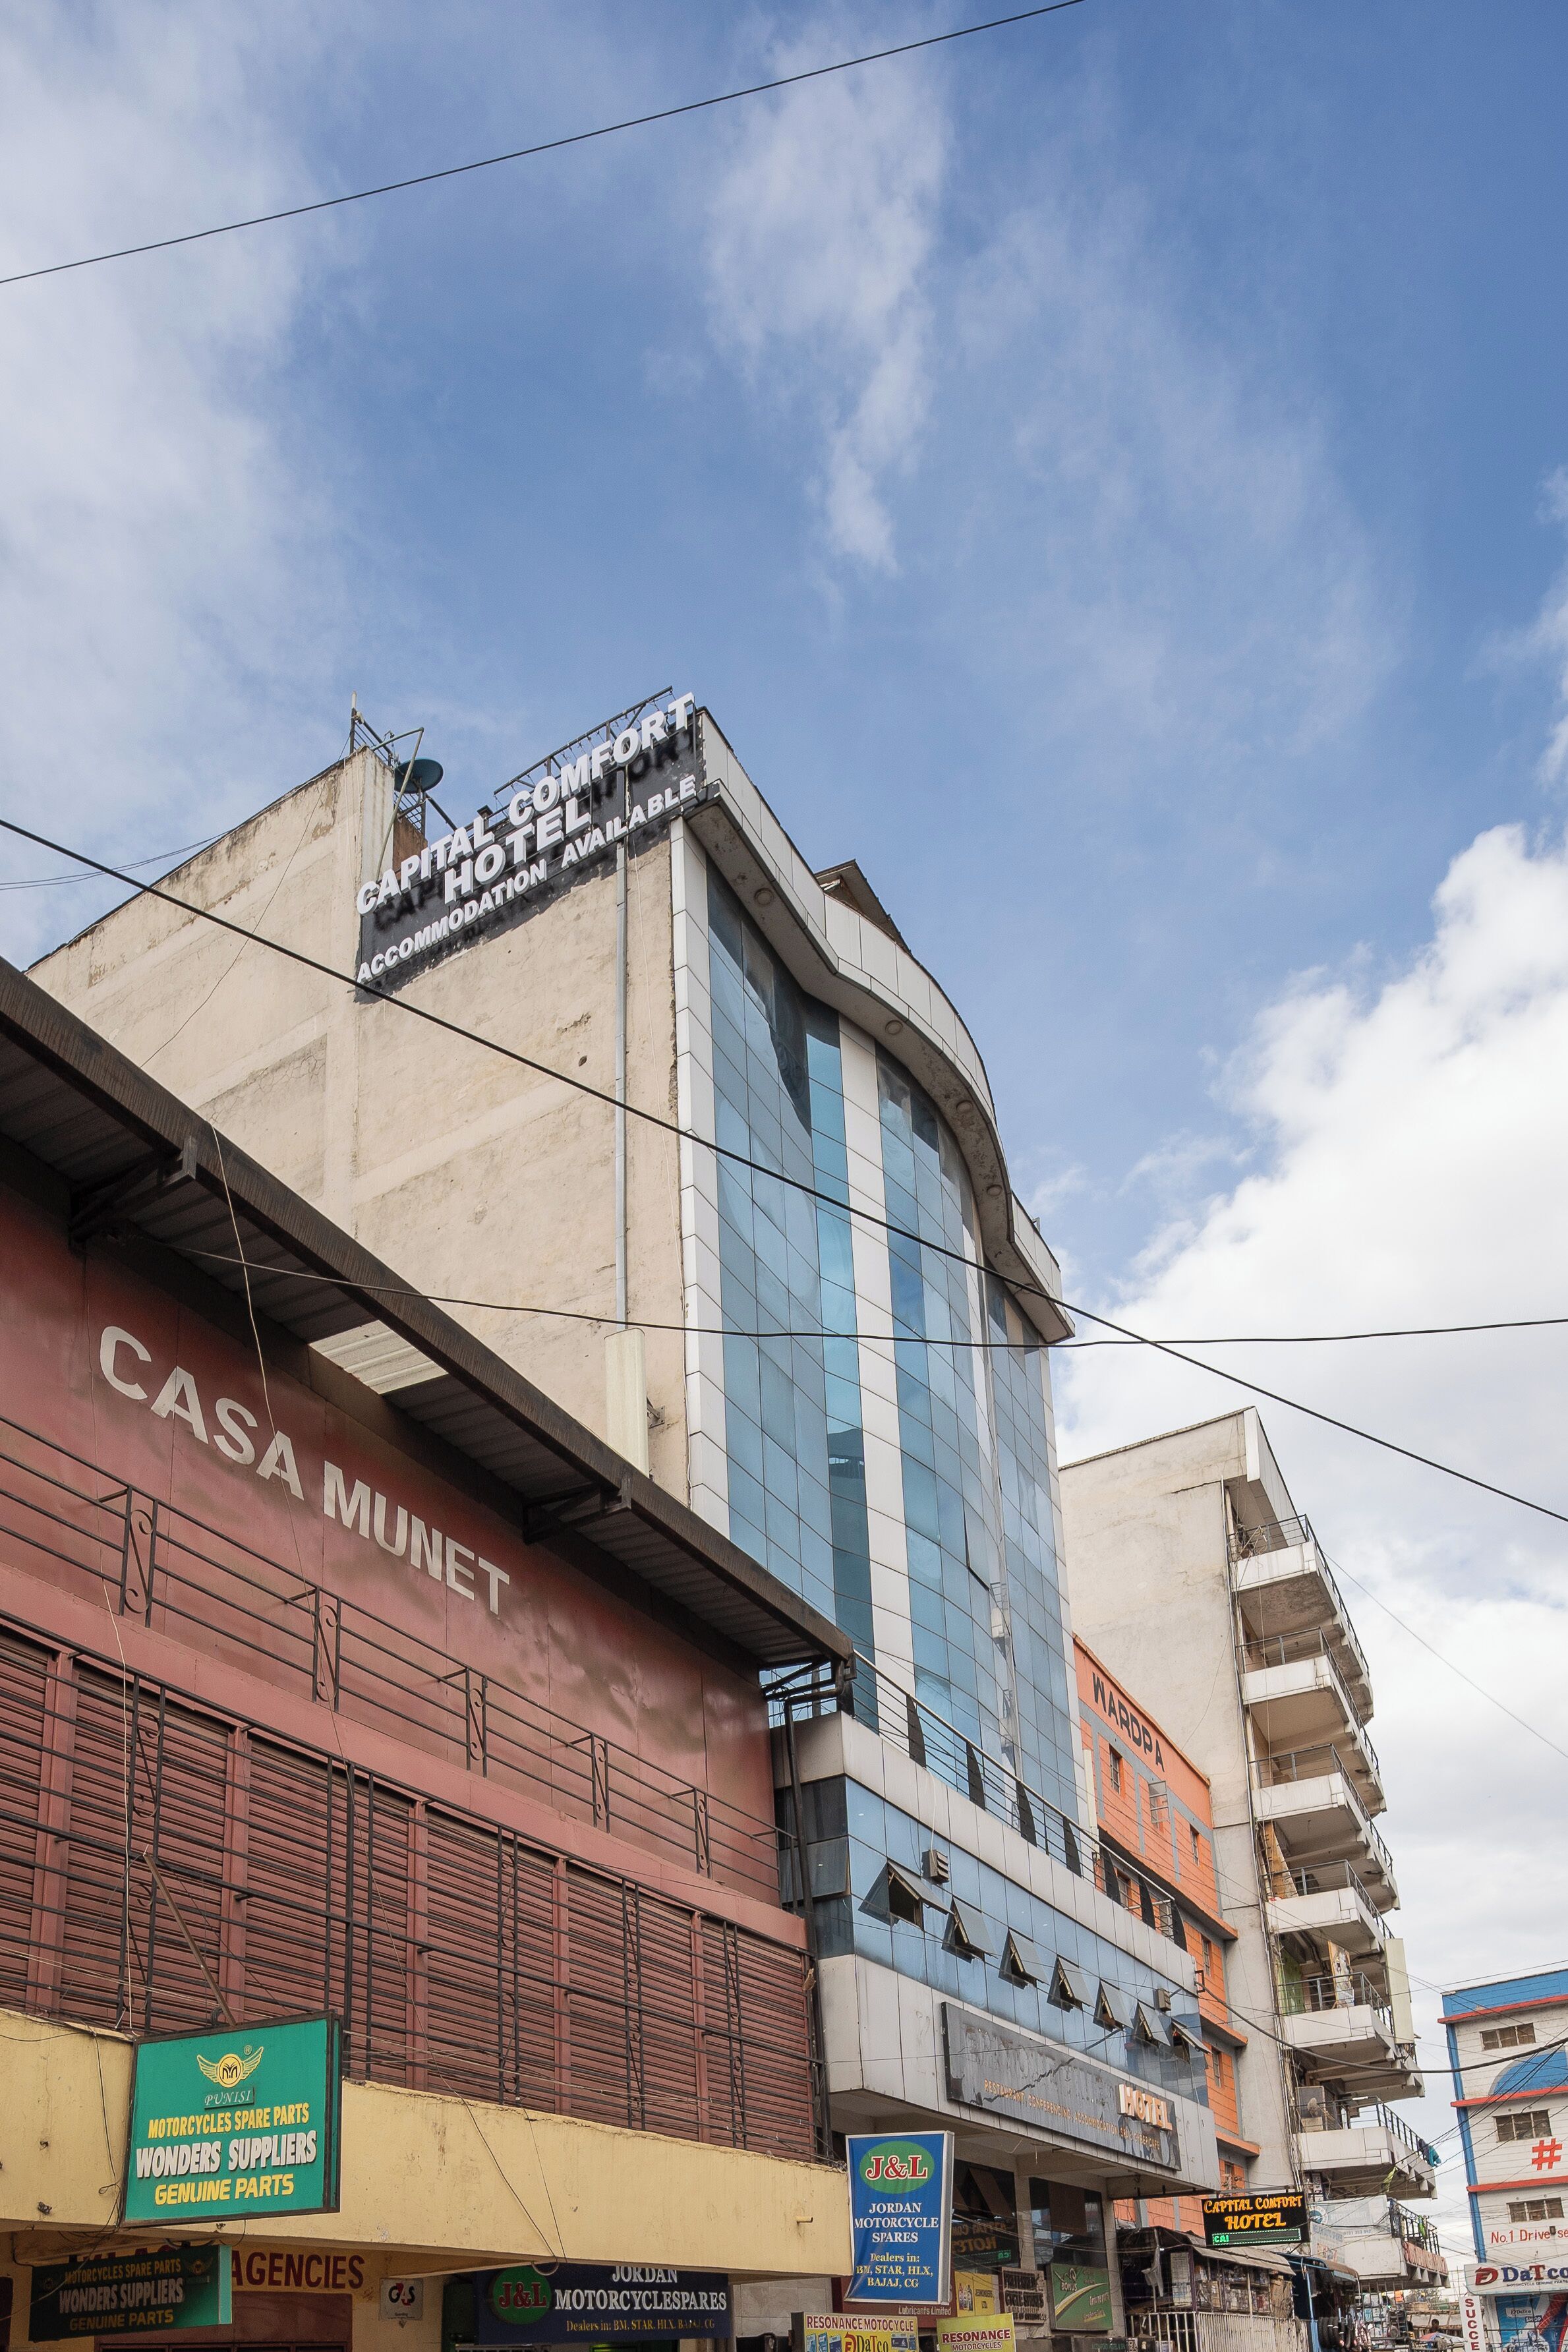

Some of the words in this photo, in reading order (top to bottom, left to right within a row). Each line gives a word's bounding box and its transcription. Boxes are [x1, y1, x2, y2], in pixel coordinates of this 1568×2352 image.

[356, 815, 494, 916] CAPITAL
[508, 692, 695, 827] COMFORT
[444, 796, 591, 905] HOTEL
[357, 859, 547, 984] ACCOMMODATION
[561, 775, 696, 869] AVAILABLE
[100, 1326, 305, 1500] CASA
[323, 1459, 510, 1616] MUNET
[204, 2090, 252, 2105] PUNISI
[1119, 2084, 1173, 2131] HOTEL
[148, 2111, 231, 2138] MOTORCYCLES
[235, 2107, 271, 2131] SPARE
[274, 2102, 309, 2126] PARTS
[136, 2141, 222, 2178] WONDERS
[229, 2130, 317, 2171] SUPPLIERS
[865, 2154, 928, 2180] J&L
[155, 2179, 231, 2205] GENUINE
[235, 2173, 295, 2199] PARTS
[869, 2202, 922, 2214] JORDAN
[1204, 2199, 1253, 2214] CAPITAL
[1255, 2195, 1303, 2210] COMFORT
[854, 2217, 939, 2229] MOTORCYCLE
[1224, 2212, 1287, 2230] HOTEL
[872, 2232, 919, 2243] SPARES
[870, 2252, 904, 2262] Dealers
[906, 2252, 920, 2262] in:
[65, 2265, 123, 2285] MOTORCYCLES
[125, 2261, 152, 2278] SPARE
[154, 2258, 181, 2274] PARTS
[232, 2250, 365, 2289] AGENCIES
[612, 2266, 678, 2283] JORDAN
[875, 2265, 905, 2277] STAR,
[908, 2266, 934, 2277] HLX,
[867, 2277, 902, 2289] BAJAJ,
[904, 2278, 919, 2287] CG
[1060, 2281, 1078, 2291] BONUS
[59, 2284, 119, 2314] WONDERS
[120, 2278, 185, 2308] SUPPLIERS
[388, 2283, 416, 2306] G4S
[498, 2281, 547, 2308] J&L
[555, 2289, 726, 2310] MOTORCYCLESPARES
[70, 2314, 126, 2331] GENUINE
[129, 2309, 175, 2326] PARTS
[898, 2305, 930, 2316] Lubricants
[931, 2306, 951, 2316] Limited
[566, 2319, 599, 2332] Dealers
[600, 2320, 612, 2331] in:
[806, 2316, 863, 2330] RESONANCE
[864, 2318, 914, 2332] MOTOCYCLE
[942, 2328, 1010, 2343] RESONANCE
[951, 2341, 1002, 2351] MOTORCYCLES
